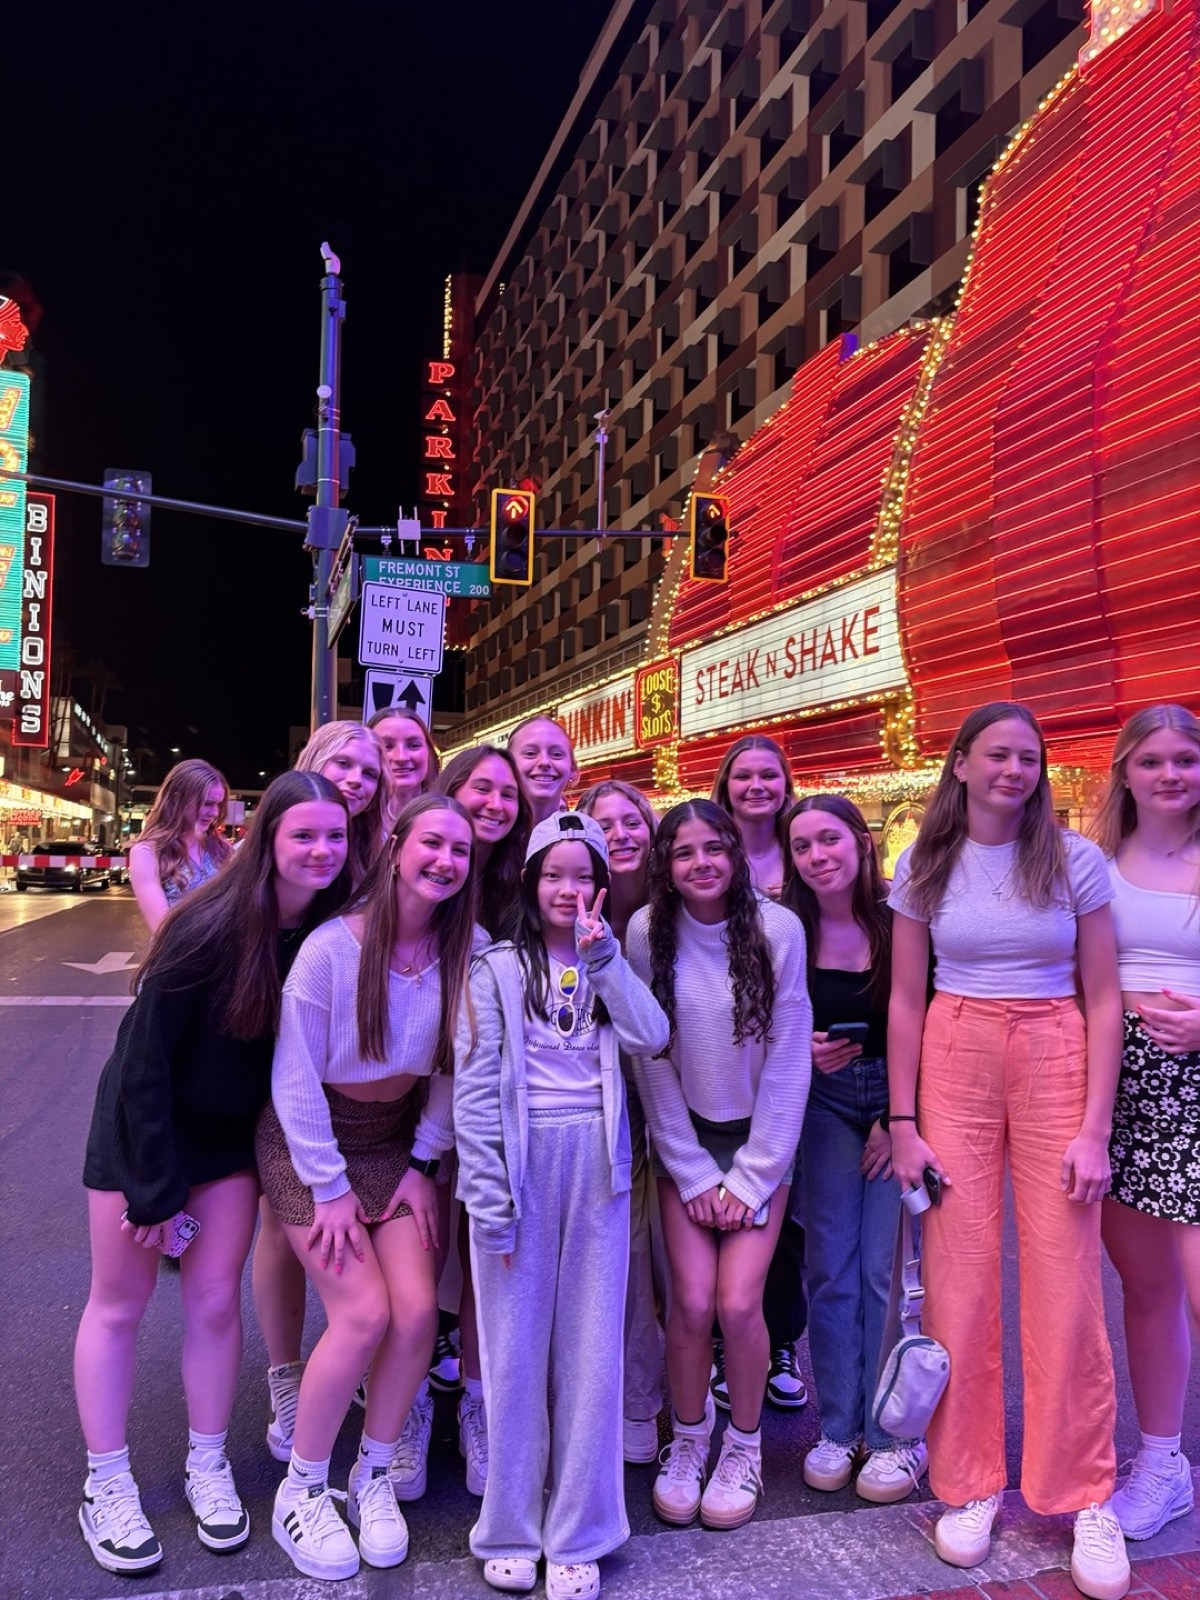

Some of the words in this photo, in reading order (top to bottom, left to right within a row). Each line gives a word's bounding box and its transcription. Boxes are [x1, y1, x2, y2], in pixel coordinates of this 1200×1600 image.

[424, 361, 456, 607] PARKIN
[379, 561, 442, 577] FREMONT
[444, 565, 461, 579] ST
[469, 584, 490, 595] 200
[20, 502, 48, 734] BINIONS
[371, 594, 400, 610] LEFT
[406, 598, 439, 616] LANE
[381, 618, 425, 638] MUST
[367, 641, 399, 657] TURN
[407, 647, 436, 661] LEFT
[695, 648, 761, 706] STEAK
[765, 651, 777, 679] N
[783, 605, 881, 679] SHAKE
[641, 667, 674, 701] LOOSE
[641, 709, 673, 739] SLOTS
